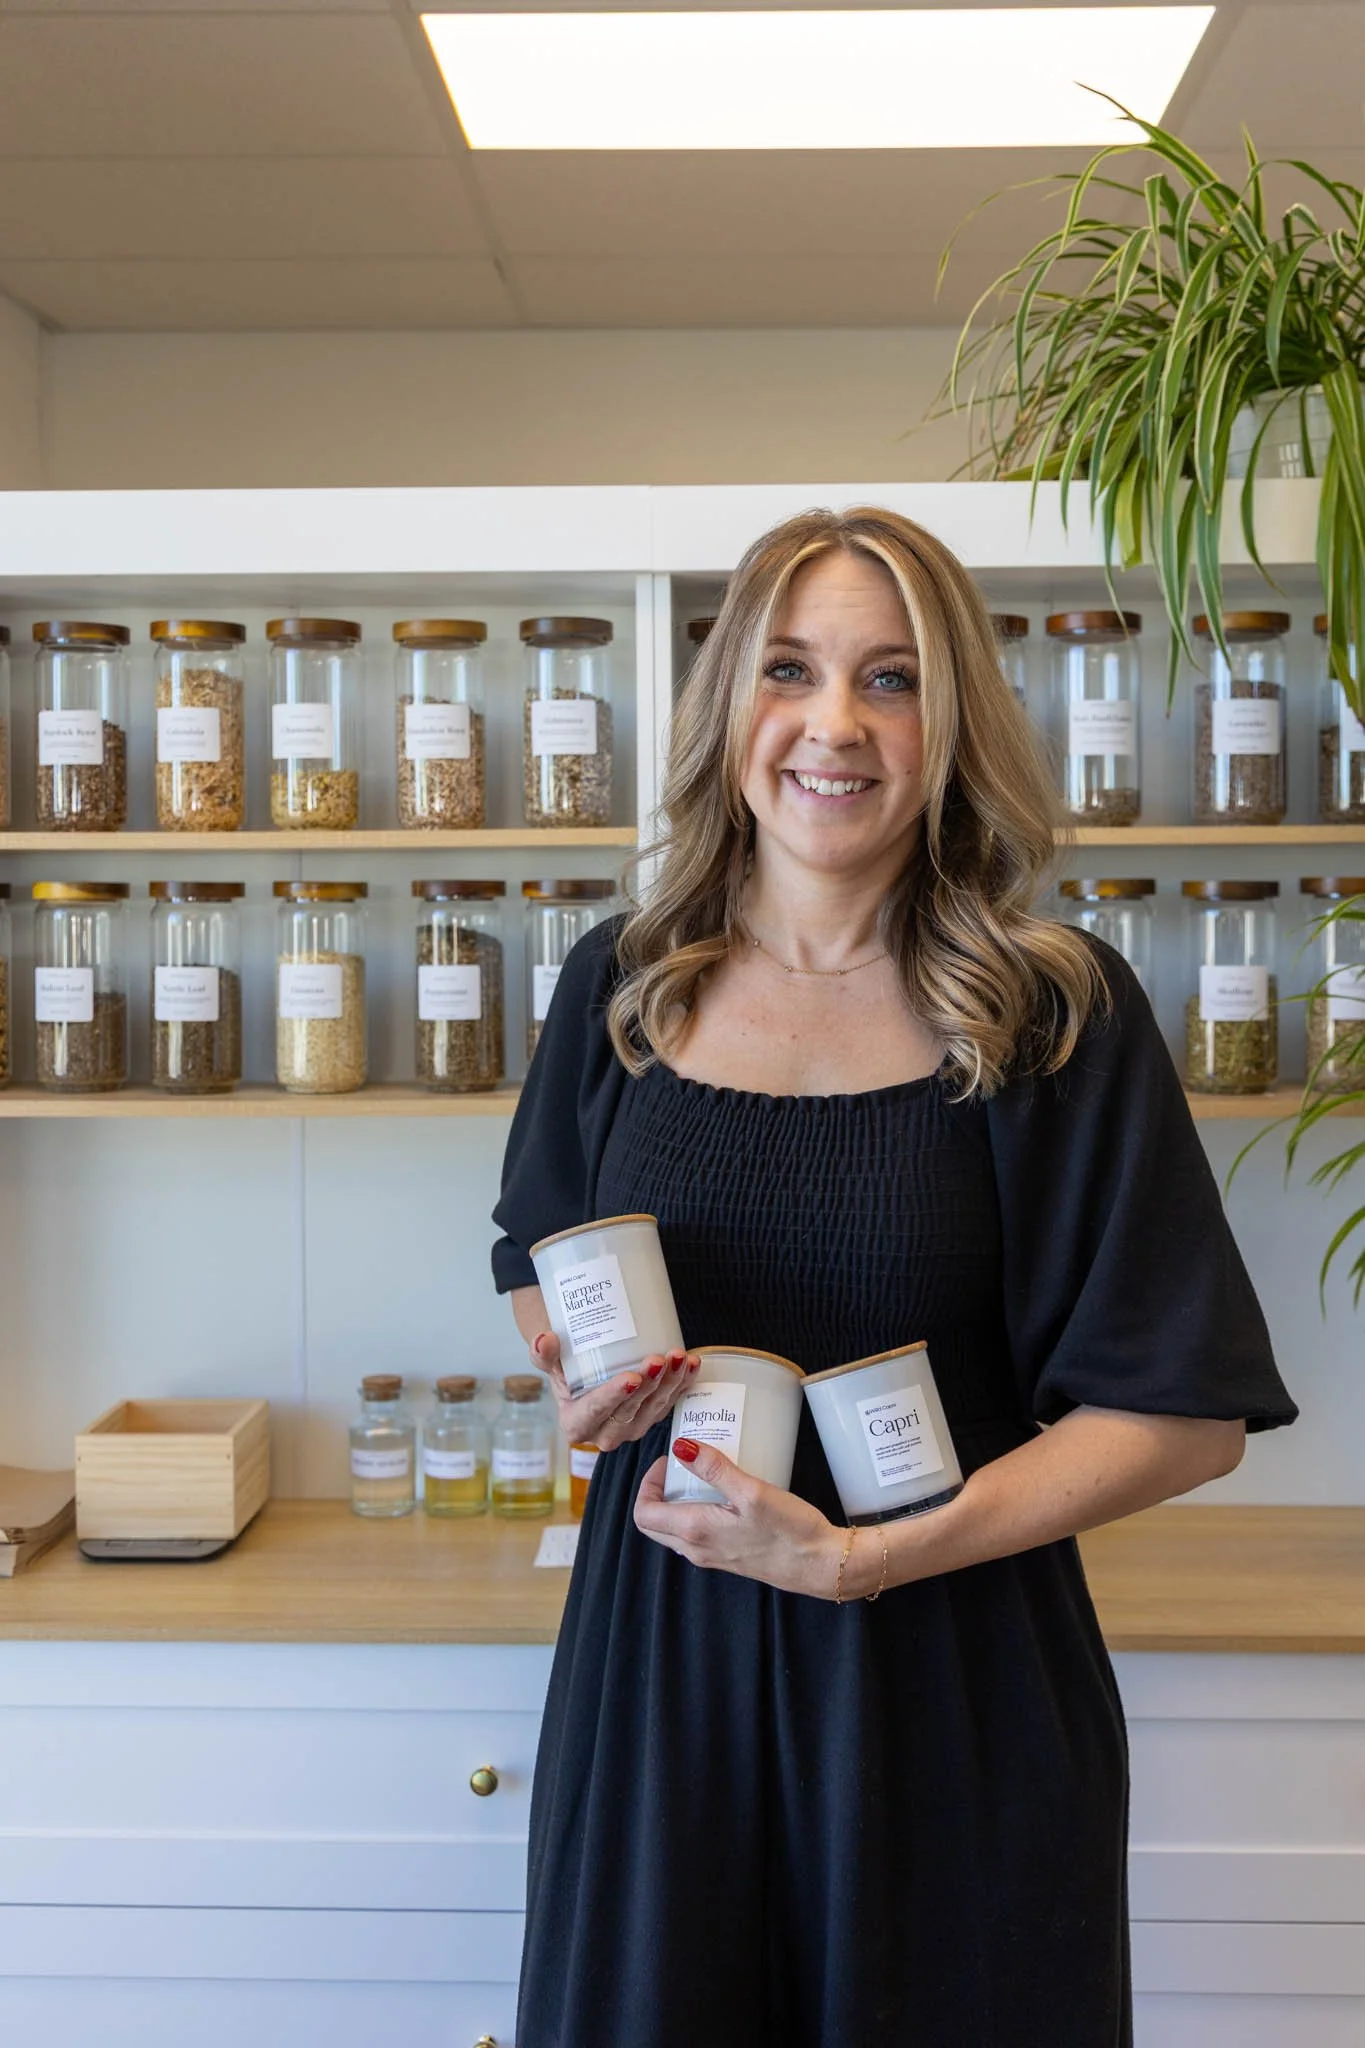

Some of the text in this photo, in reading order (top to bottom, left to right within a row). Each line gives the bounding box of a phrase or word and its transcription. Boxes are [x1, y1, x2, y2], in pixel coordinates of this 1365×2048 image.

[562, 1279, 613, 1302] Farmers
[564, 1292, 605, 1313] Market
[683, 1408, 736, 1427] Magnolia
[869, 1409, 920, 1437] Capri
